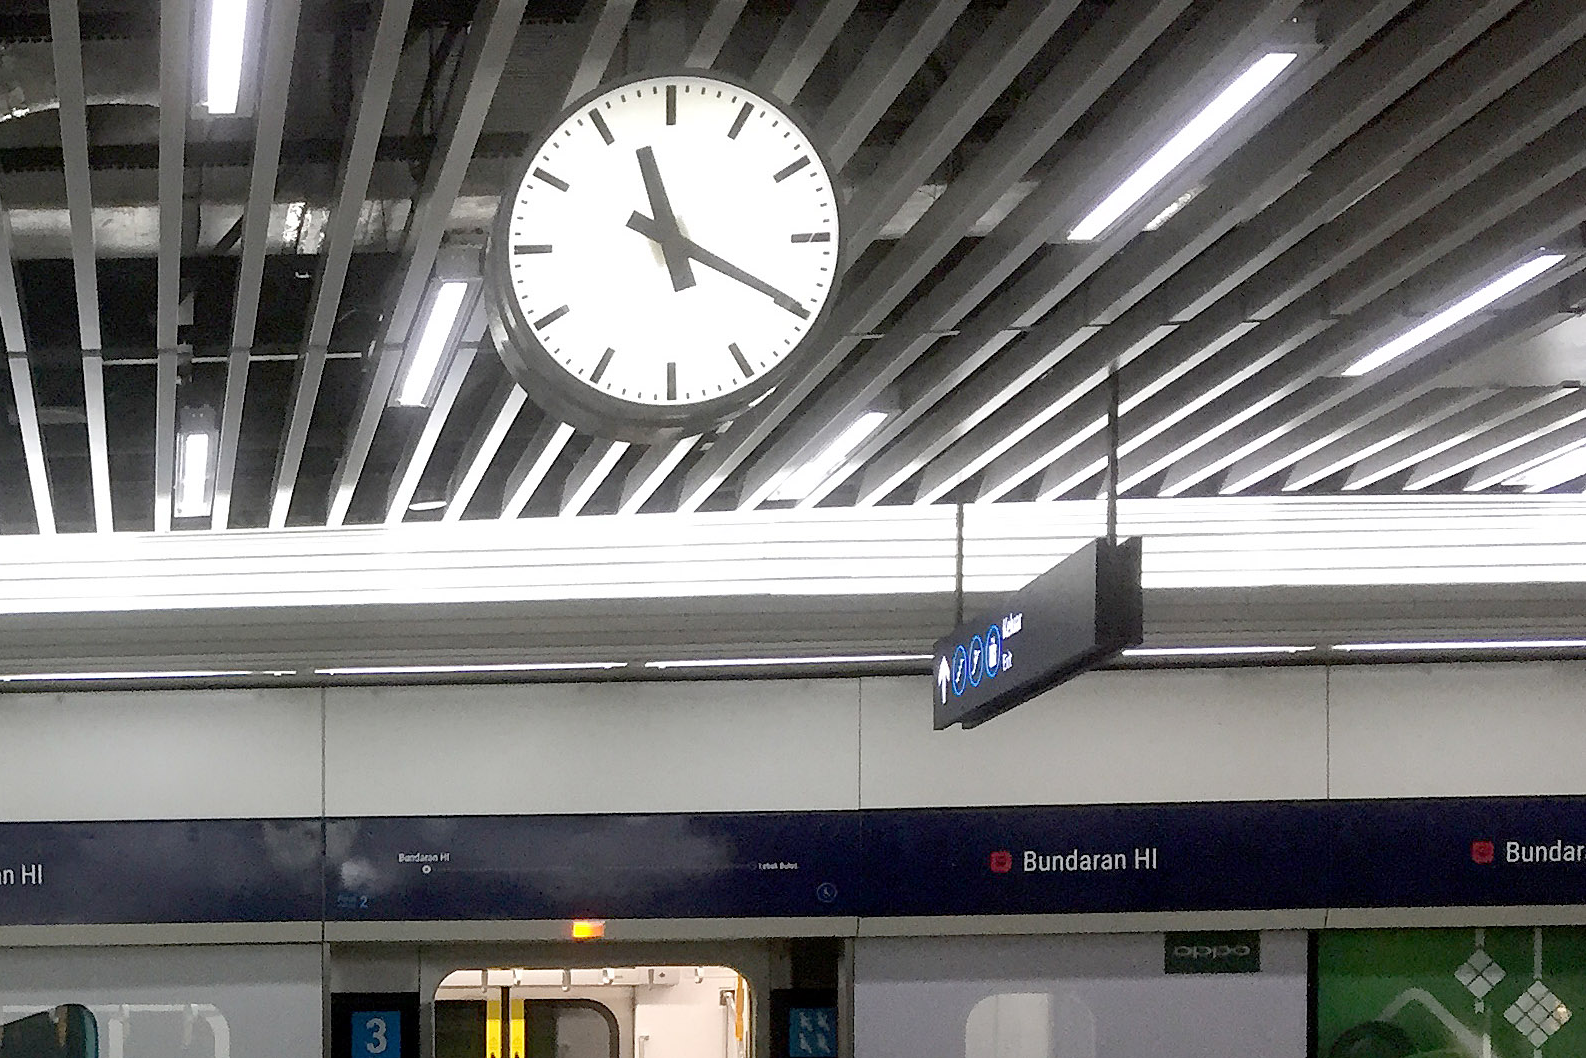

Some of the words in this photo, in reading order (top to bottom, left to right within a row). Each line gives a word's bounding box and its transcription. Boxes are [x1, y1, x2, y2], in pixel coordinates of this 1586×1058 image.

[1023, 848, 1127, 872] Bundaran
[1134, 847, 1157, 870] HI
[1506, 839, 1586, 863] Bundar
[21, 864, 43, 885] HI
[359, 895, 368, 908] 2
[366, 1017, 387, 1054] 3
